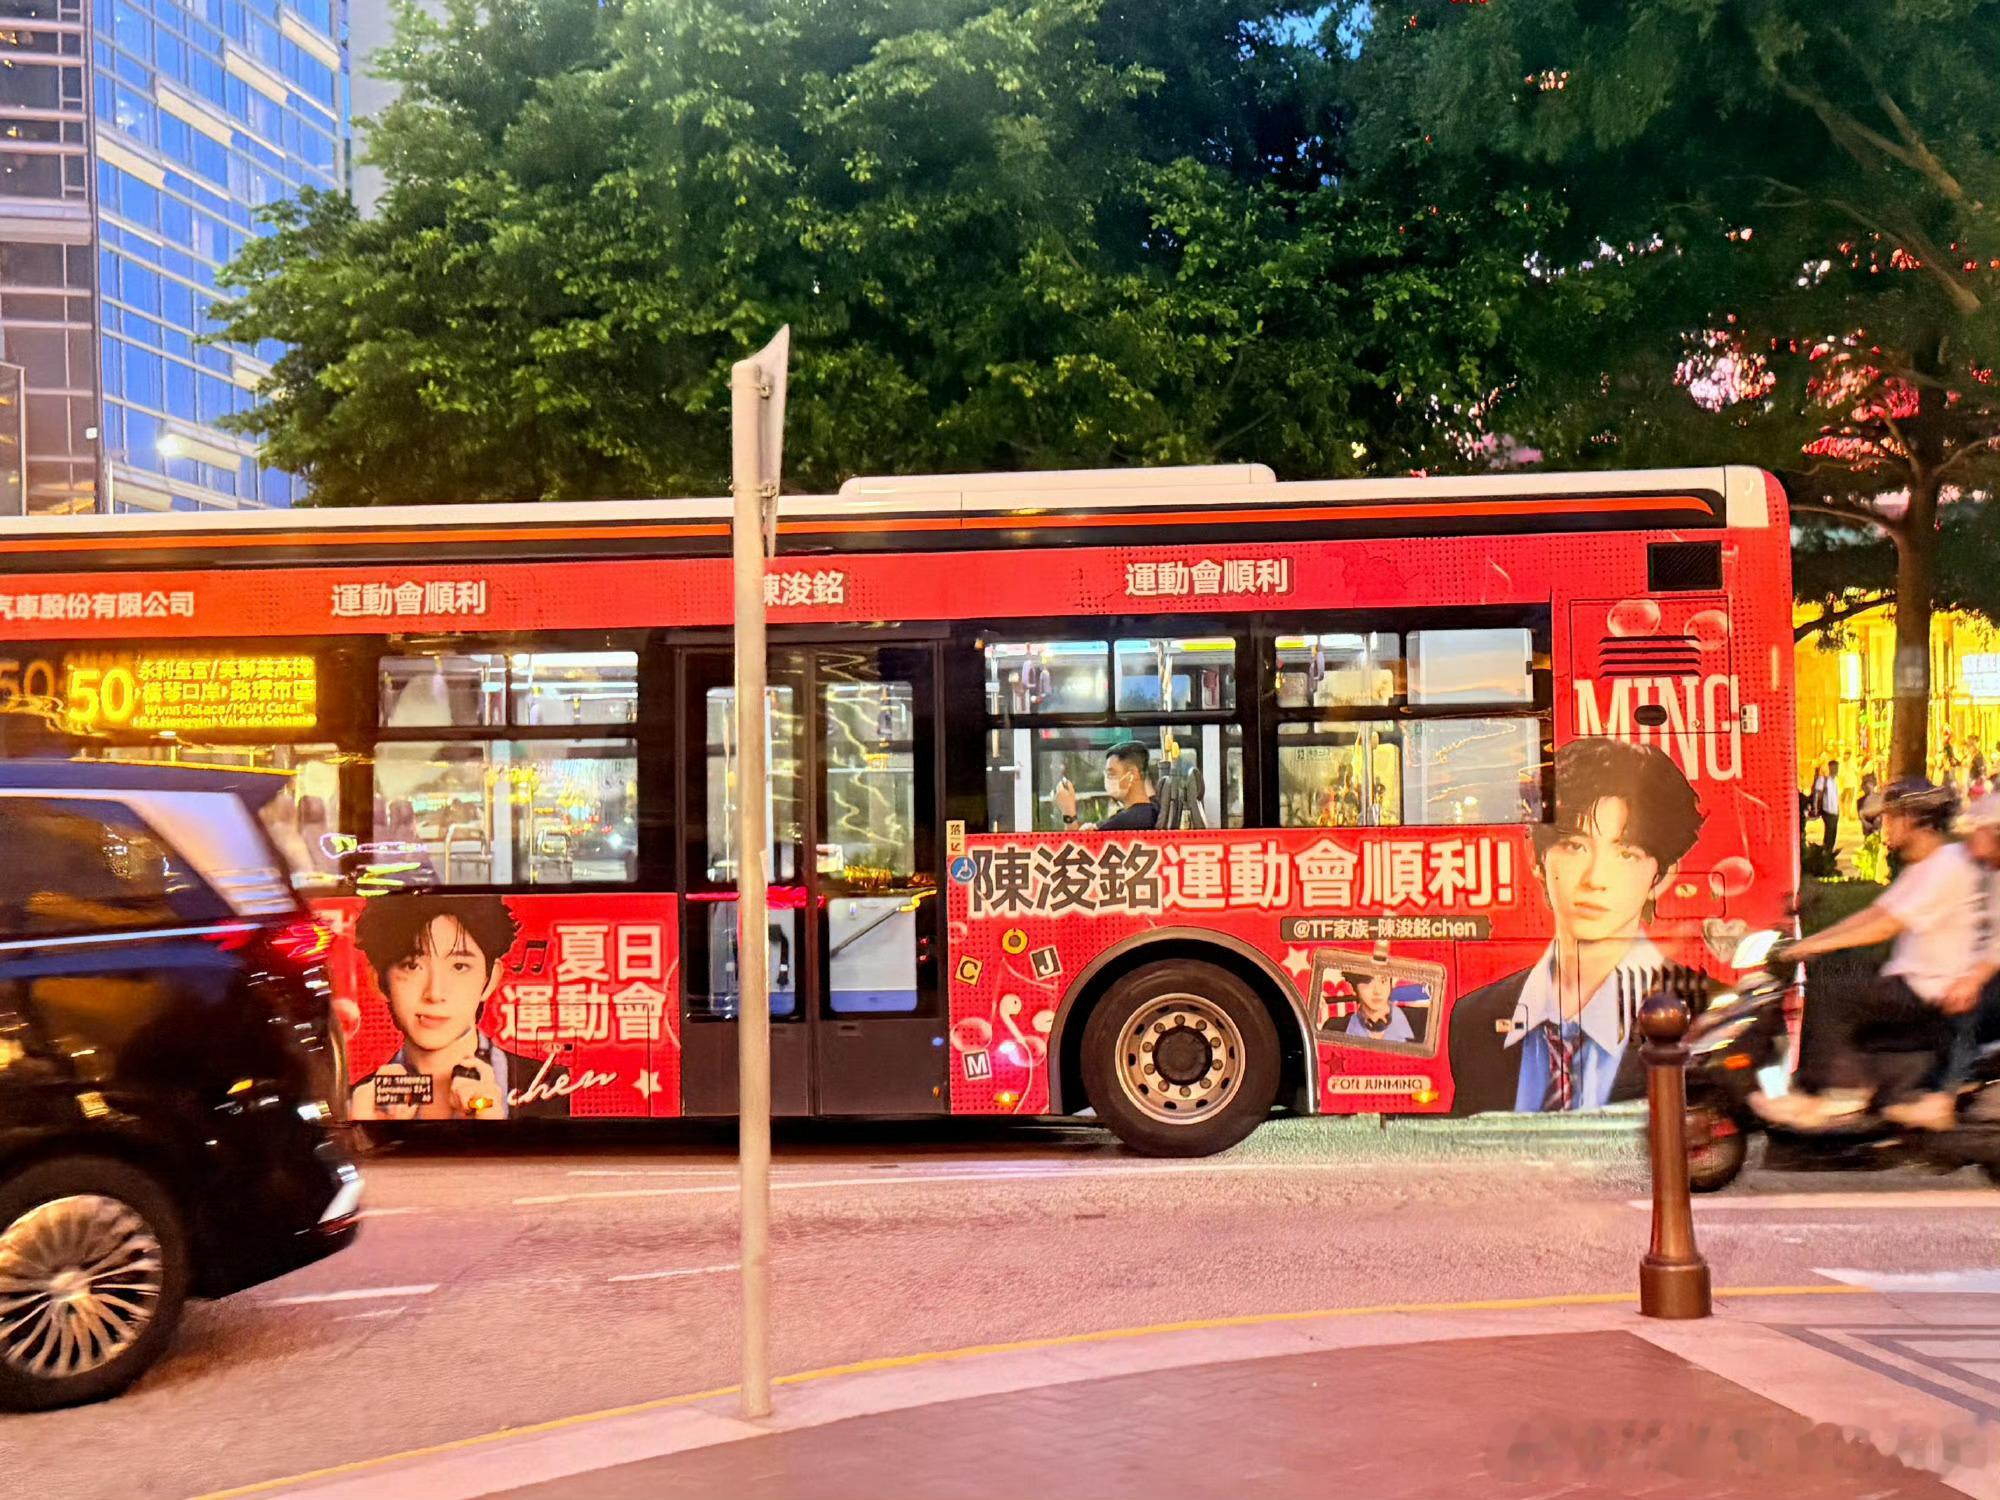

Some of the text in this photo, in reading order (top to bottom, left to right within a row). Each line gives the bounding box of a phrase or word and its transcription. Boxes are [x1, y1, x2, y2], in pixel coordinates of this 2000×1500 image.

[331, 580, 486, 617] 運動會順利
[1125, 558, 1288, 596] 運動會順利
[67, 668, 135, 722] 50
[1573, 673, 1743, 781] MING
[971, 837, 1513, 912] 陳浚銘運動會順利!
[556, 924, 661, 983] 夏日
[500, 980, 667, 1042] 運動會
